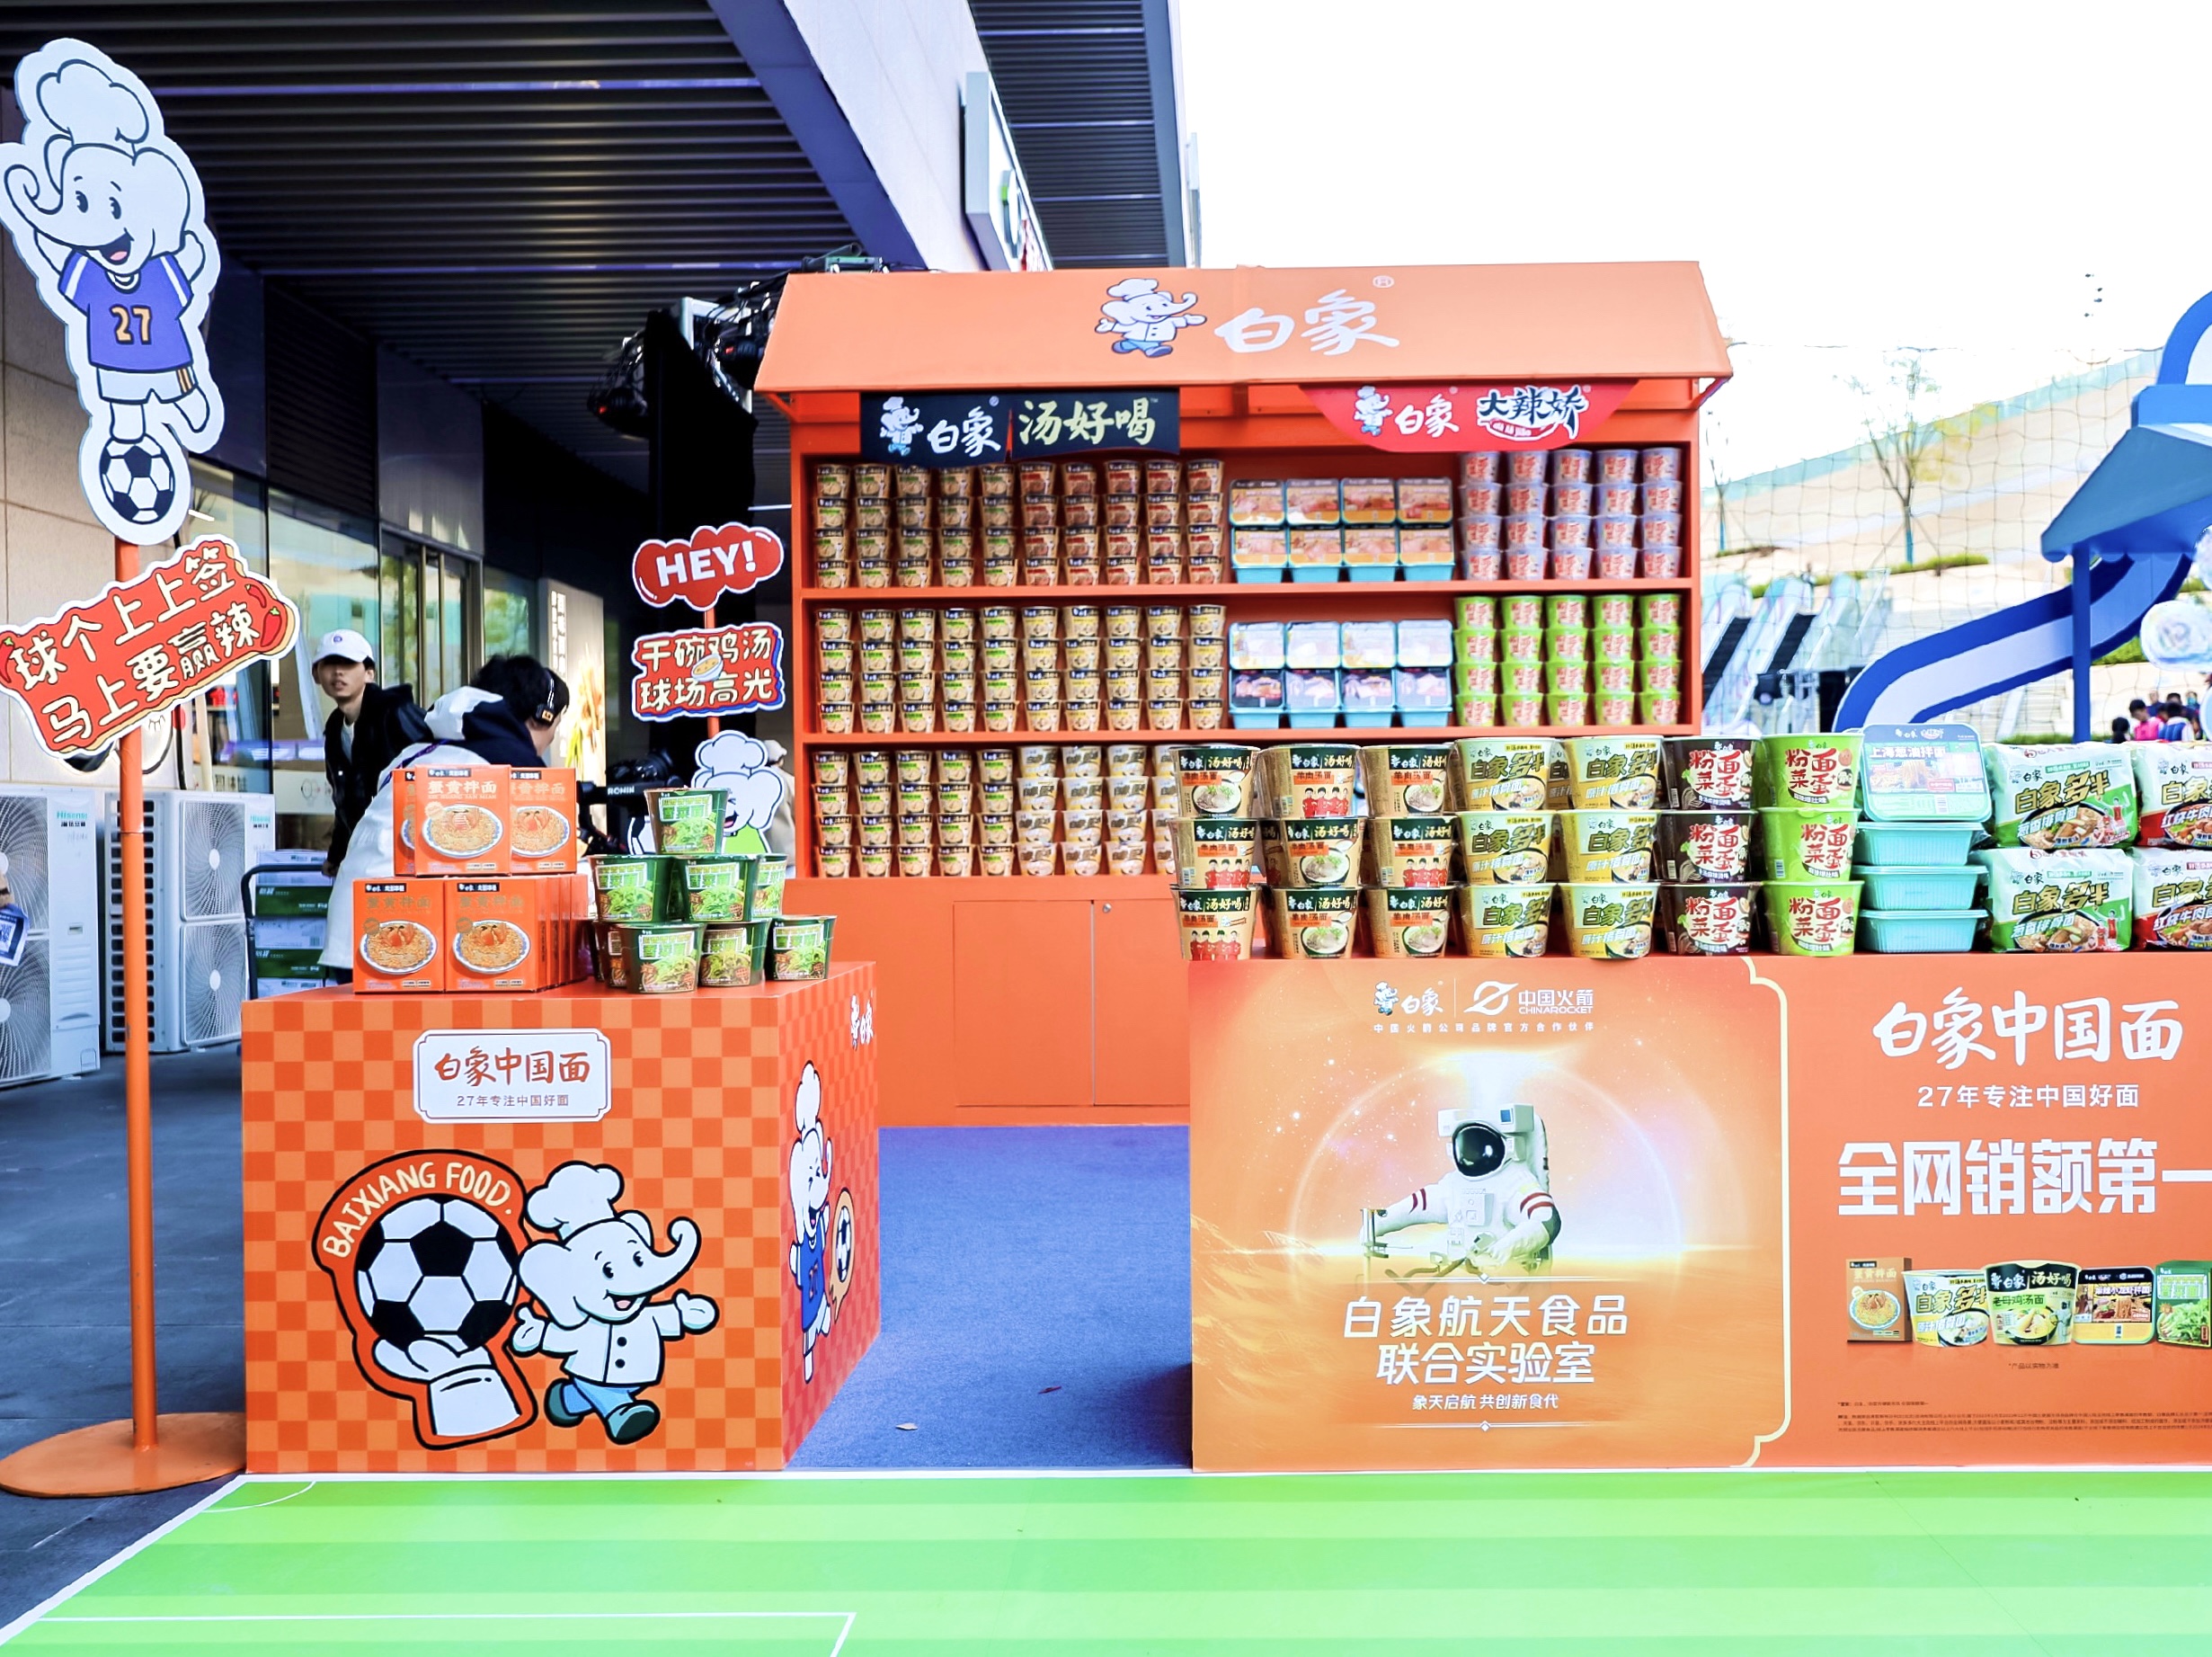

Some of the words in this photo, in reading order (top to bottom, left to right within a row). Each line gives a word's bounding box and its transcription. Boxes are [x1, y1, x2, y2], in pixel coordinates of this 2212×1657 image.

[111, 306, 152, 344] 27
[1214, 289, 1399, 356] 白象
[927, 405, 1001, 457] 白象
[1018, 397, 1156, 445] 汤好喝
[1395, 394, 1460, 438] 白象
[1479, 384, 1586, 437] 大辣娇
[656, 540, 756, 587] HEY!
[9, 547, 235, 690] 球个上上签
[41, 602, 260, 744] 马上要赢辣
[640, 667, 772, 711] 球场高光
[1423, 755, 1446, 768] 汤好
[428, 780, 497, 795] 蟹黄拌面
[511, 781, 565, 796] 黄拌面
[607, 785, 635, 796] RONIN
[2015, 770, 2110, 815] 白象多半
[2161, 776, 2212, 806] 白象
[2161, 805, 2212, 829] 红烧牛肉
[1588, 824, 1652, 852] 白象多
[2012, 880, 2110, 915] 白象多半
[1400, 987, 1444, 1017] 白象
[1518, 989, 1594, 1006] 中国火箭
[1518, 1006, 1593, 1014] CHINAROCKET
[1373, 1021, 1595, 1034] 中国火箭公司品牌官方合作伙伴
[1872, 986, 2183, 1070] 白象中国面
[434, 1045, 591, 1086] 白象中国面
[457, 1093, 569, 1108] 27年专注中国好面
[1917, 1083, 2139, 1109] 27年专注中国好面
[1838, 1137, 2212, 1216] 全网销额第一
[323, 1162, 436, 1258] BAIXIANG
[2031, 1270, 2071, 1287] 汤好喝
[1343, 1294, 1629, 1338] 白象航天食品
[1993, 1294, 2045, 1306] 老母鸡汤面
[1376, 1341, 1595, 1385] 联合实验室
[1412, 1394, 1476, 1411] 象天启航
[1479, 1394, 1559, 1410] 共创新食代
